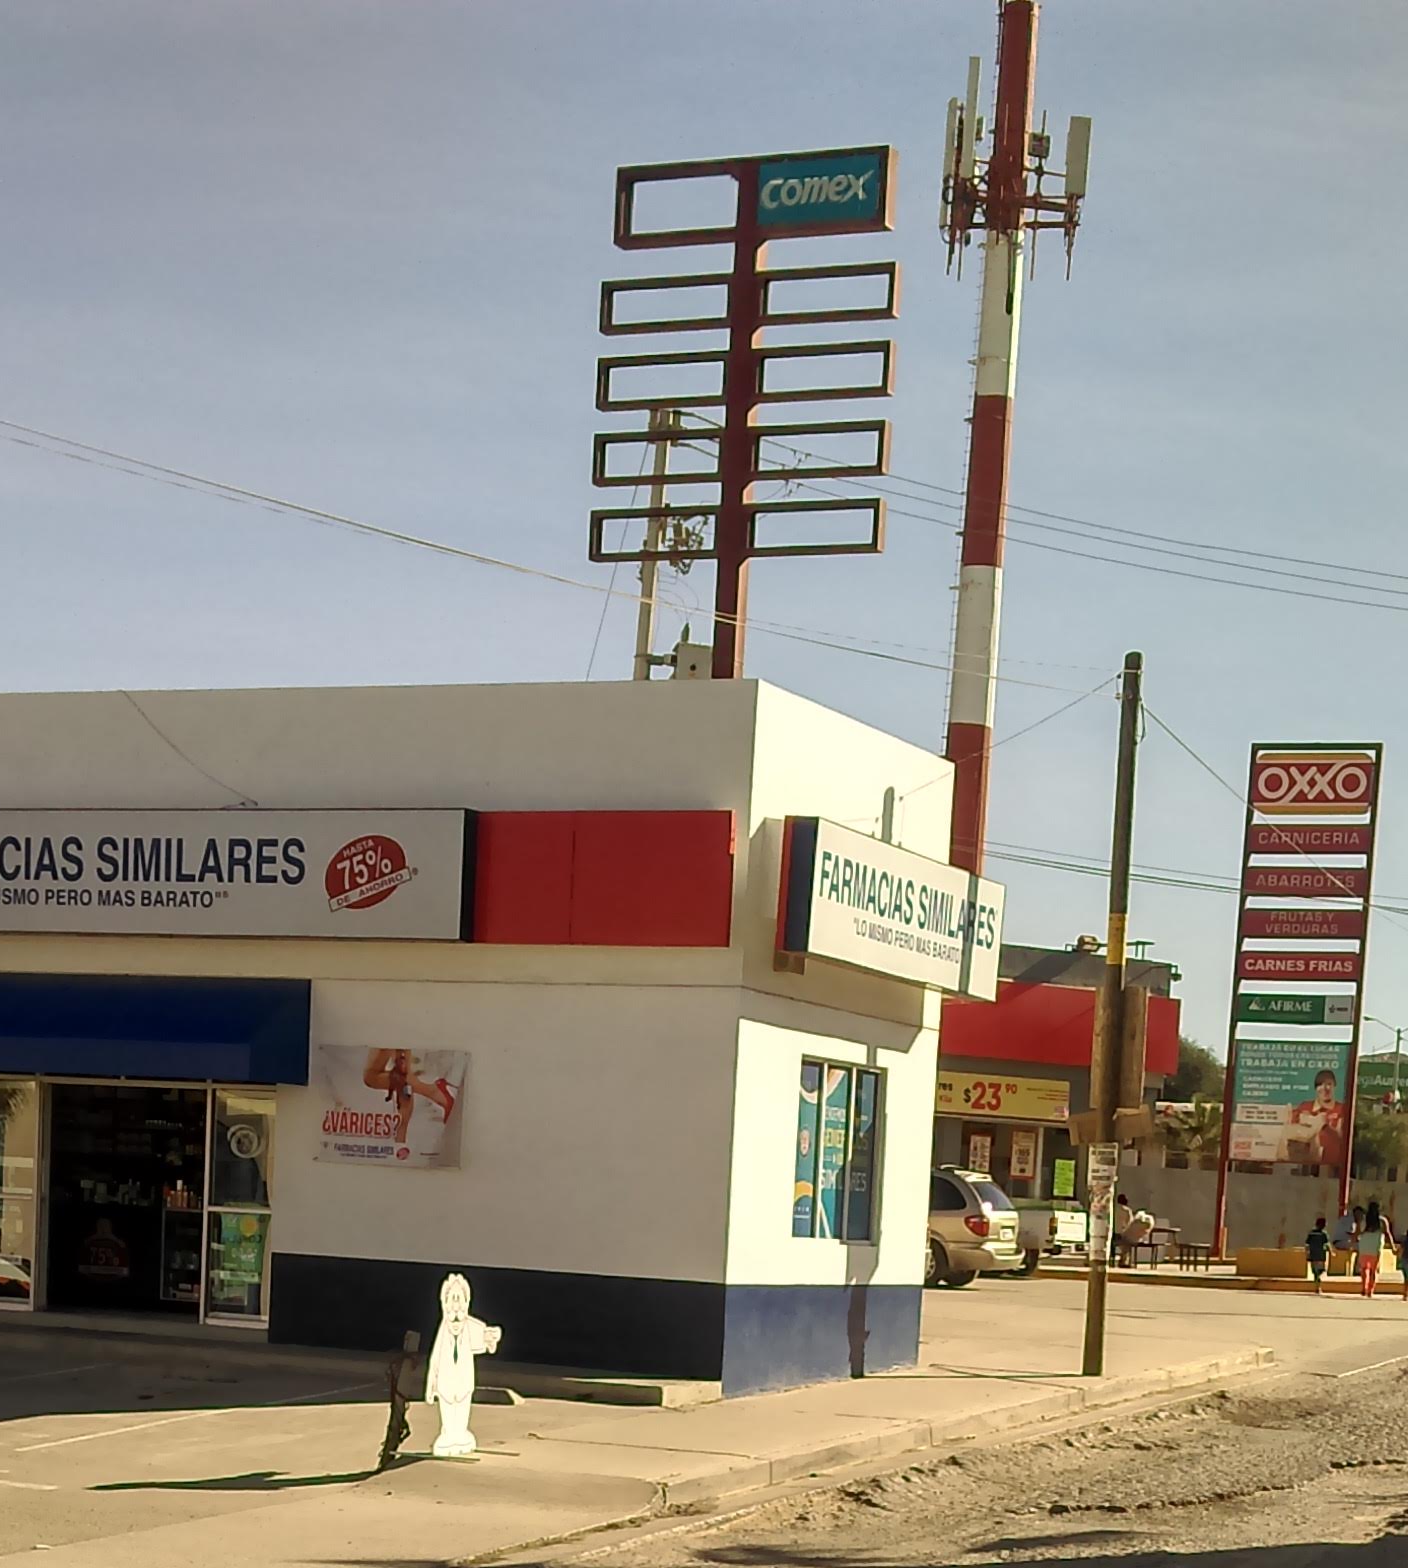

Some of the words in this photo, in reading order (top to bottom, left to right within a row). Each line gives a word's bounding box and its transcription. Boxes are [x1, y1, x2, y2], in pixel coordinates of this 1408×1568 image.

[761, 169, 874, 209] comex
[1257, 763, 1368, 803] OXXO
[342, 839, 375, 858] HASTA
[1258, 831, 1360, 845] CARNICERIA
[96, 836, 306, 885] SIMILARES
[336, 845, 392, 890] 75%
[44, 888, 92, 907] PERO
[97, 889, 136, 907] MAS
[336, 895, 351, 907] DE
[357, 873, 404, 898] AHORRO
[819, 850, 915, 926] FARMACIAS
[917, 884, 996, 950] SIMILARES
[1265, 923, 1339, 934] VERDURAS
[1270, 911, 1323, 922] FRUTAS
[1326, 912, 1335, 922] Y
[868, 921, 893, 946] MISMO
[894, 930, 914, 951] PERO
[915, 936, 932, 957] MAS
[1244, 959, 1306, 972] CARNES
[1308, 960, 1353, 972] FRIAS
[1267, 1000, 1313, 1012] AFIRME
